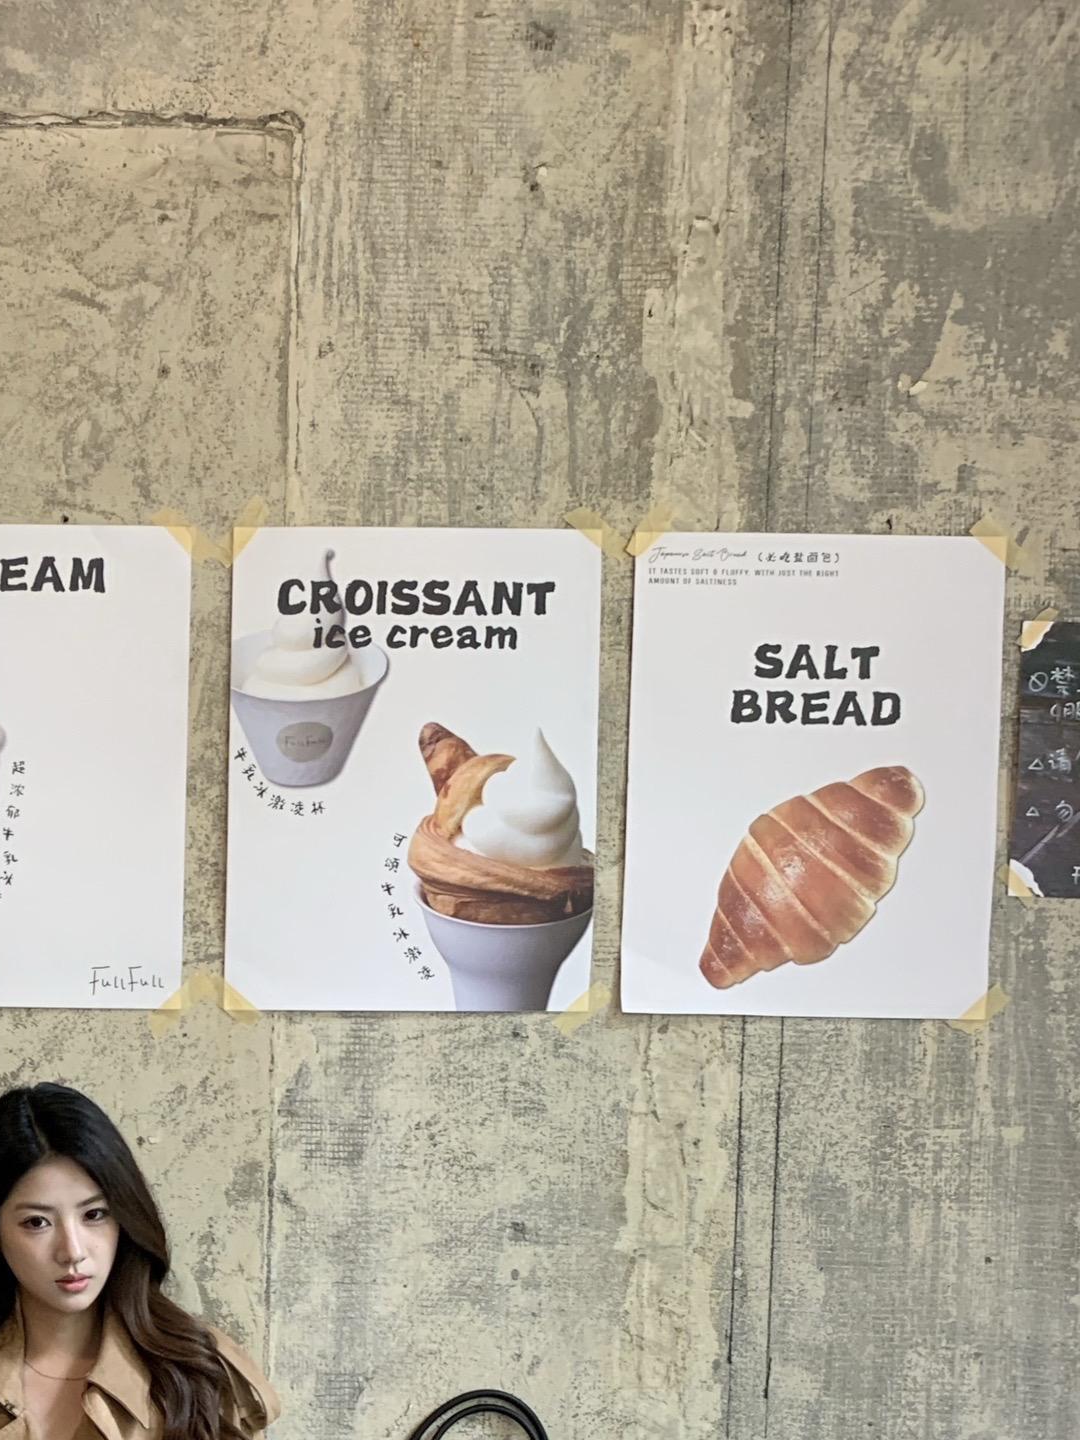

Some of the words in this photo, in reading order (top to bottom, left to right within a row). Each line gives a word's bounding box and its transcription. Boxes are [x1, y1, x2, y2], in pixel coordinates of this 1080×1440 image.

[648, 577, 680, 585] AMOUNT
[683, 577, 692, 585] OF
[695, 578, 737, 586] SALTINESS
[660, 567, 688, 576] TASTES
[691, 568, 709, 576] SOFT
[754, 569, 775, 577] WITH
[778, 569, 796, 577] JUST
[799, 569, 813, 577] THE
[816, 569, 839, 577] RIGHT
[277, 578, 556, 616] CROISSANT
[313, 618, 372, 650] ice
[386, 624, 518, 650] cream
[754, 643, 881, 680] SALT
[731, 689, 902, 726] BREAD
